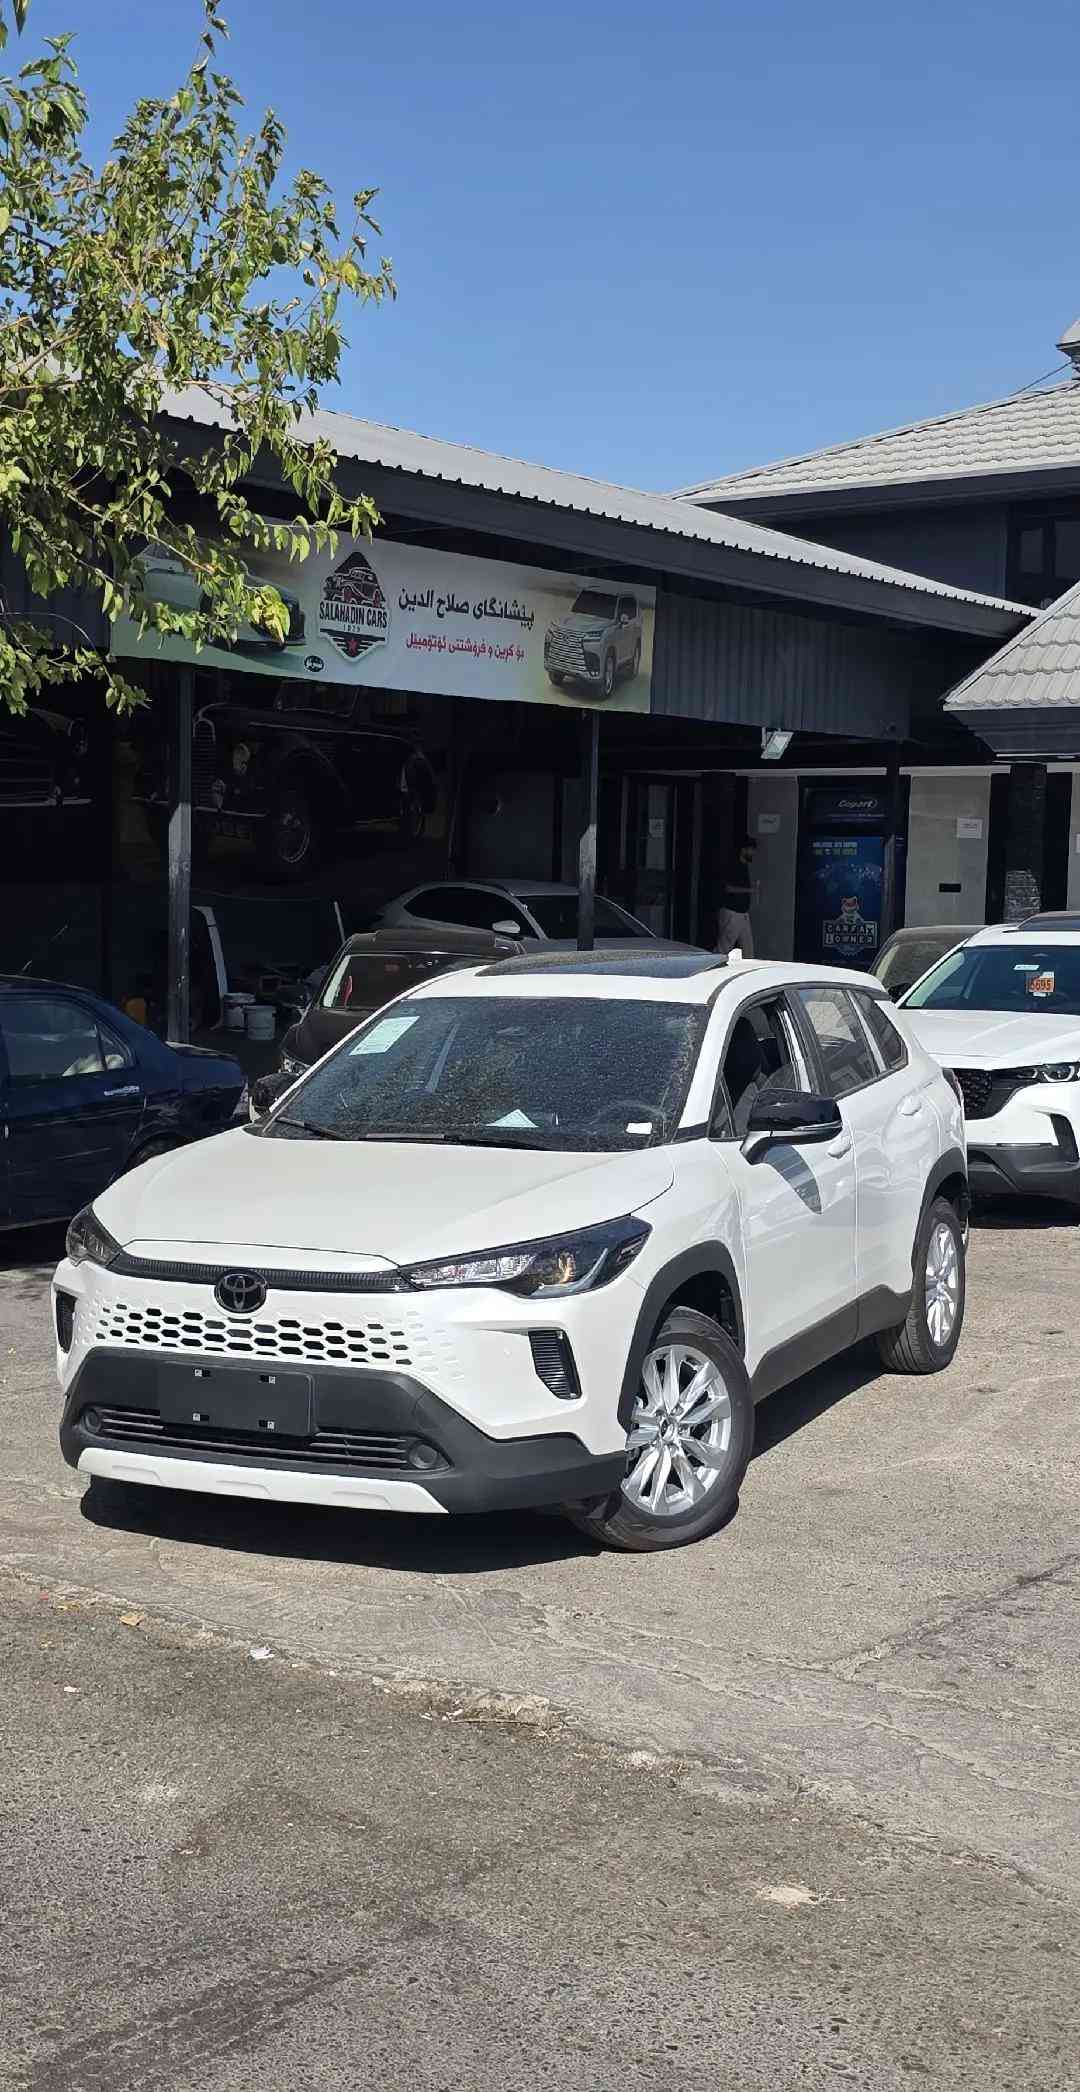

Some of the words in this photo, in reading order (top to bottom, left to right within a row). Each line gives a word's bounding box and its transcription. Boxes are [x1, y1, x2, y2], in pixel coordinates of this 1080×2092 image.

[319, 600, 365, 625] SALAHADIN
[366, 608, 388, 628] CARS
[436, 592, 469, 618] صلاح
[837, 799, 874, 809] Copart
[826, 924, 874, 934] CARFAX
